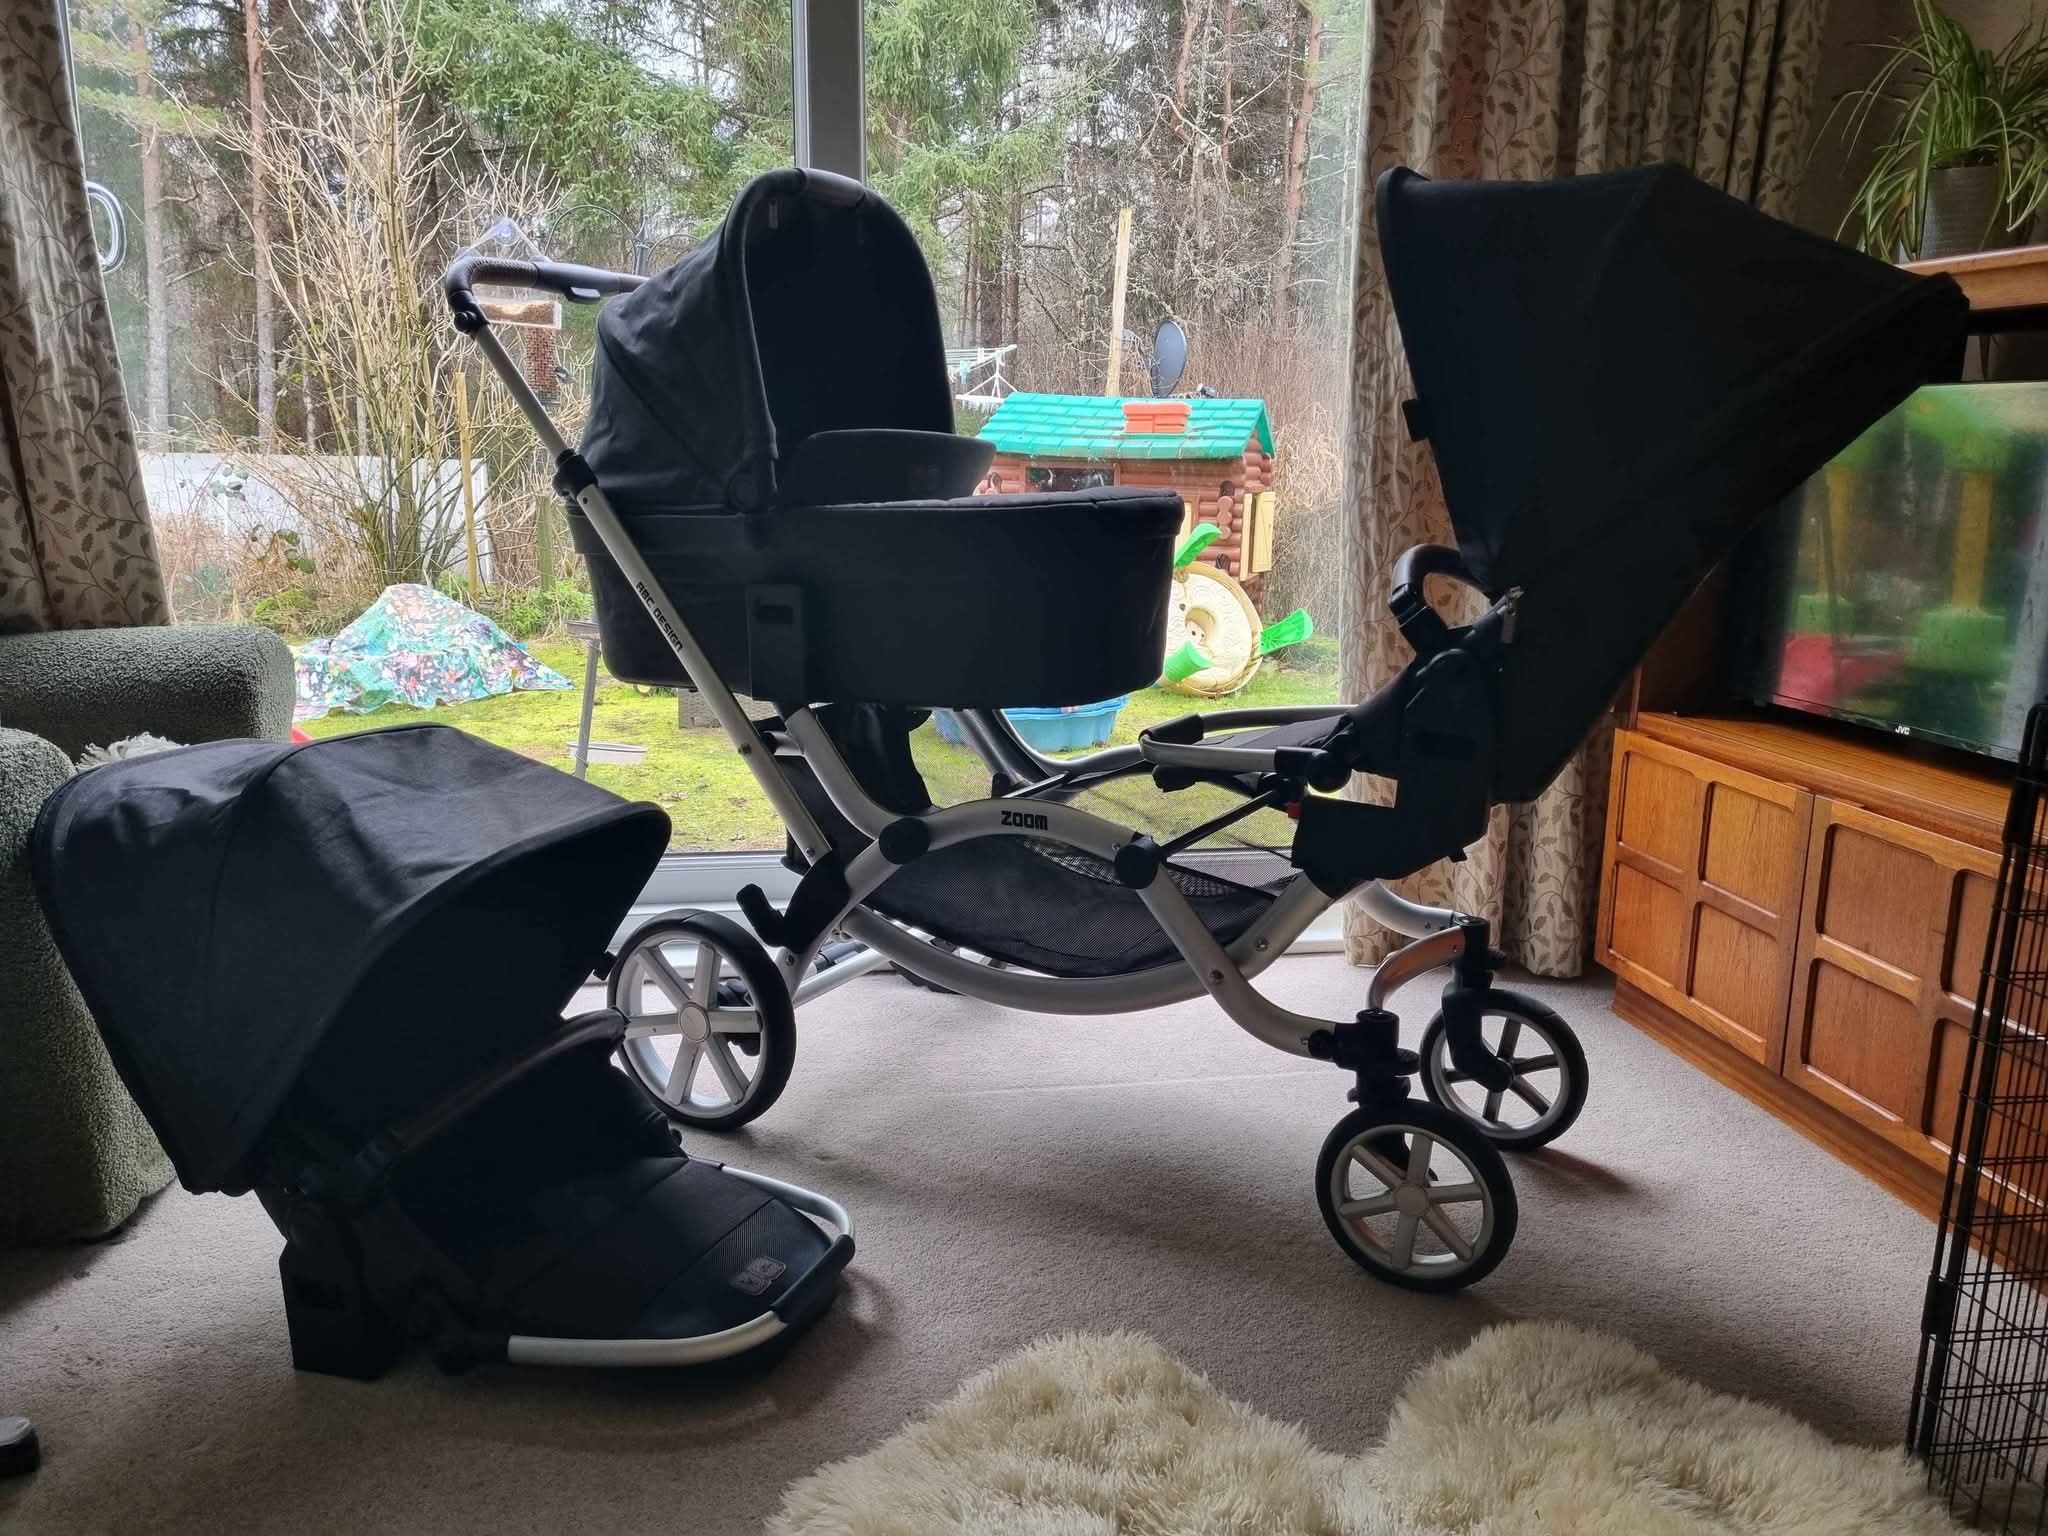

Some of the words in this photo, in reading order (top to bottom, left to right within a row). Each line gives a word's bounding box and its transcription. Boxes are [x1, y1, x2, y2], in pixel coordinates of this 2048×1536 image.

[636, 582, 655, 608] ABC
[653, 608, 683, 652] DESIGN
[1895, 725, 1910, 736] JVC
[1001, 810, 1048, 831] ZOOM
